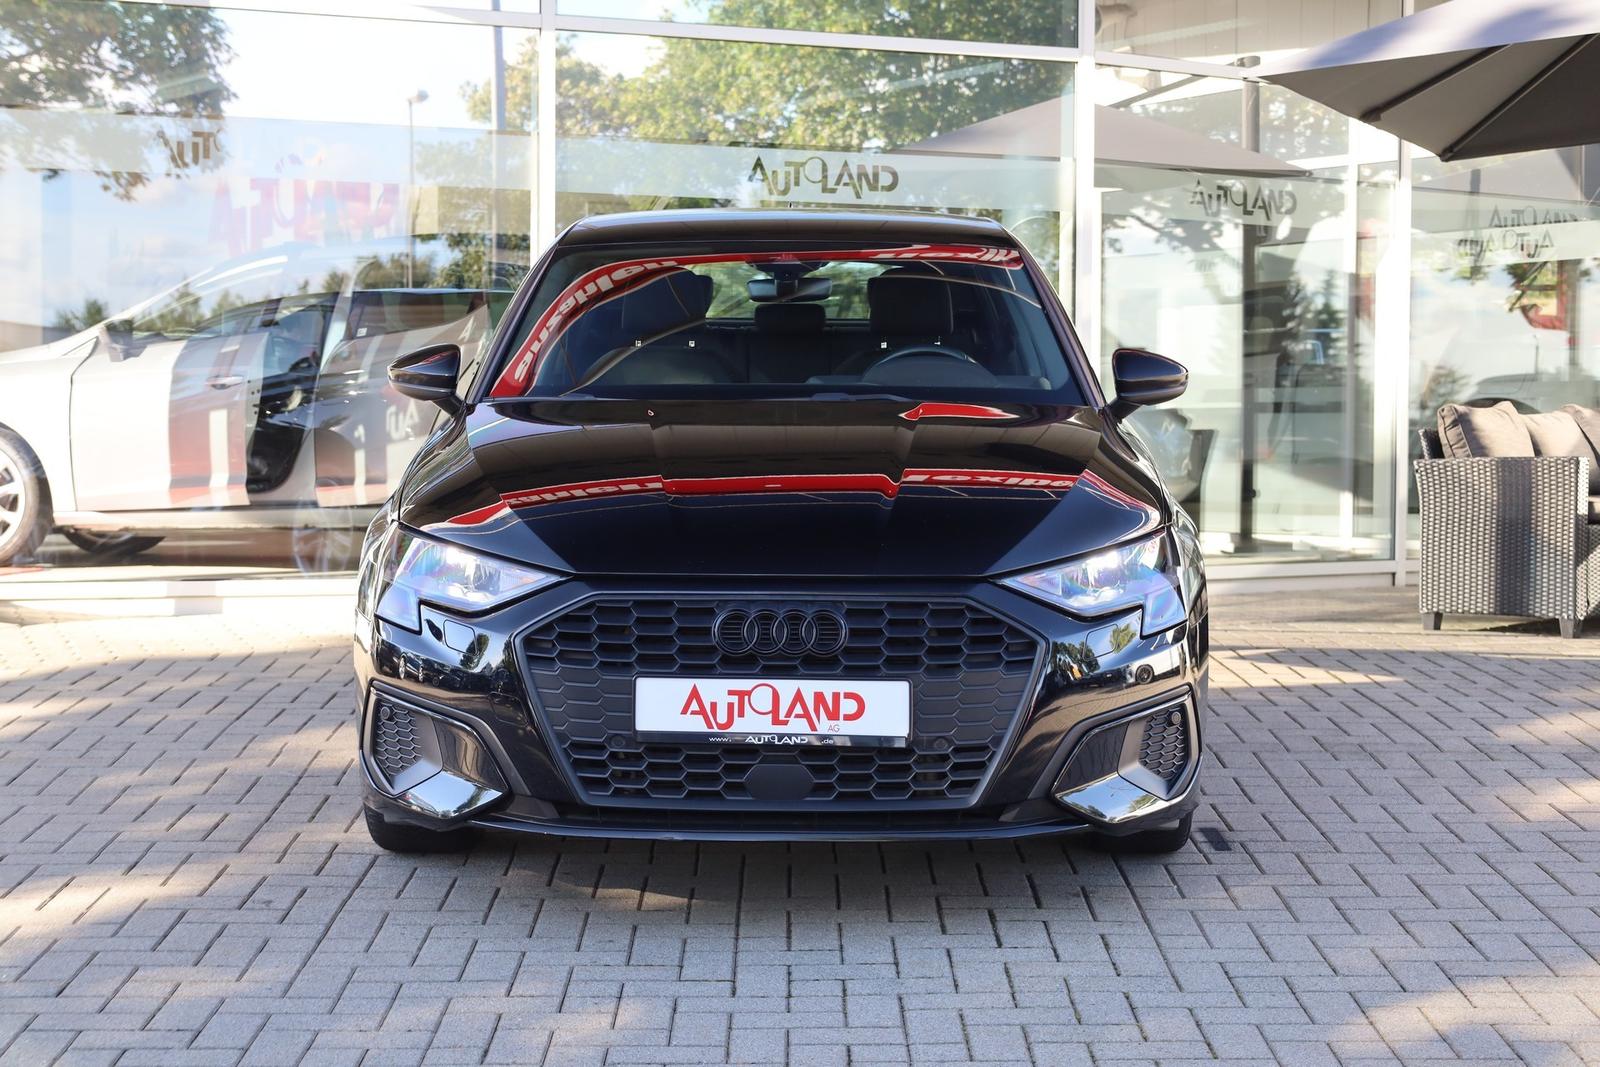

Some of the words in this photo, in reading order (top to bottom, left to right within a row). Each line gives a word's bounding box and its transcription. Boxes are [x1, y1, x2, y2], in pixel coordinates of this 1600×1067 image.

[747, 155, 899, 200] AUTOLAND
[679, 682, 867, 732] AUTOLAND
[745, 734, 808, 745] AUTOLAND
[827, 723, 841, 734] AG
